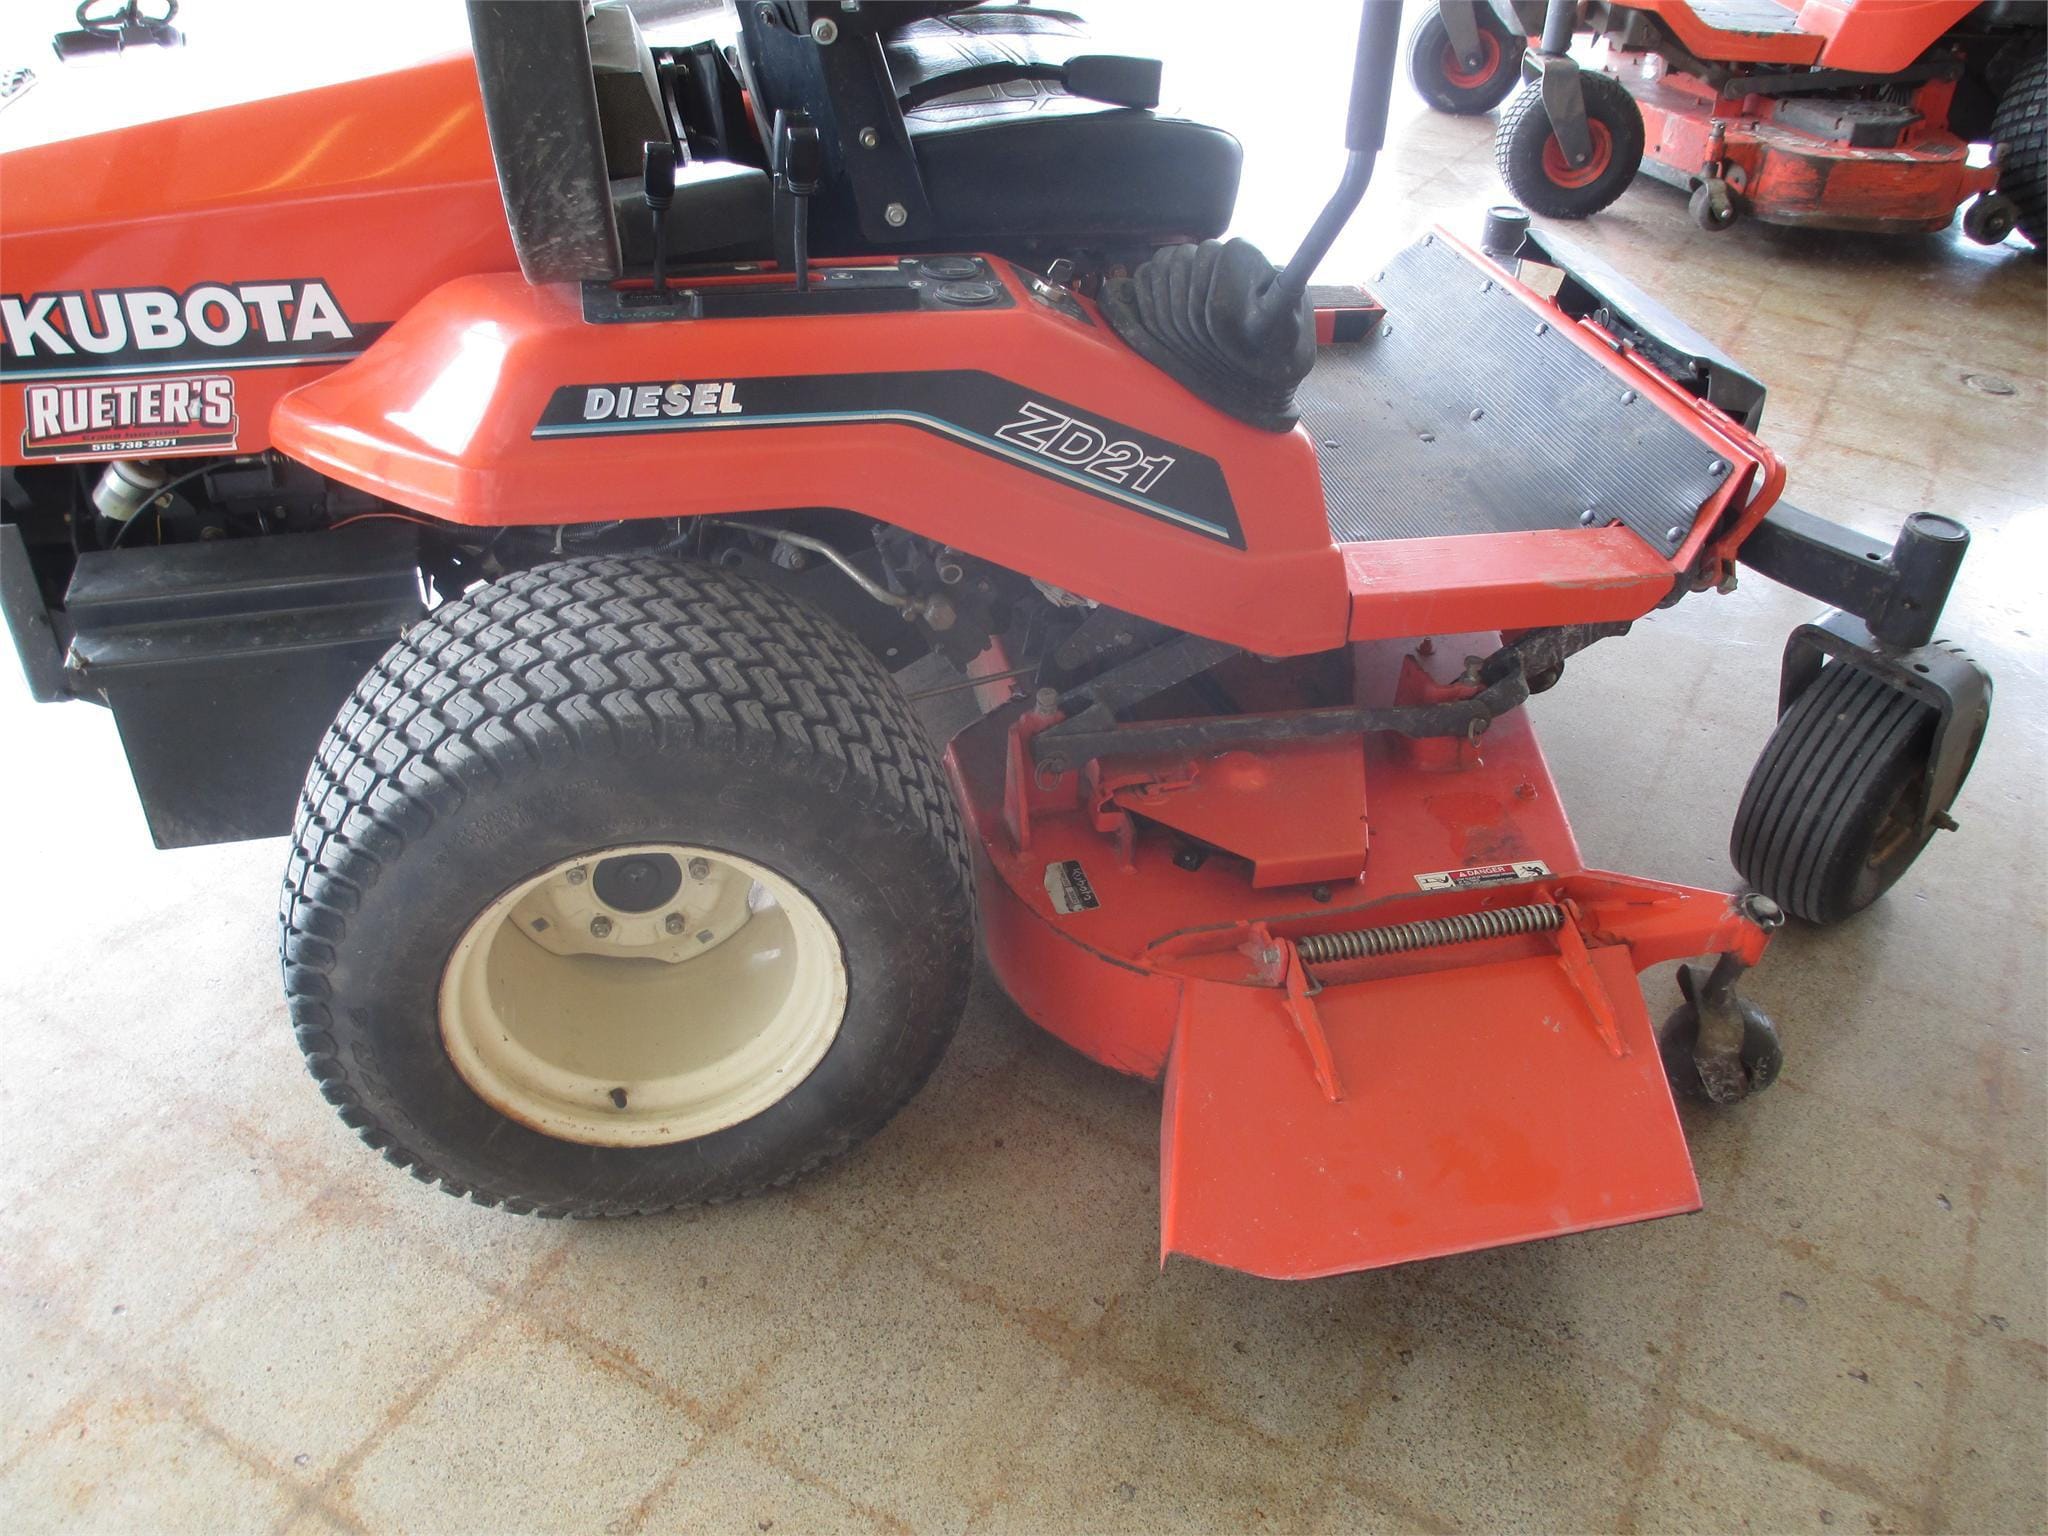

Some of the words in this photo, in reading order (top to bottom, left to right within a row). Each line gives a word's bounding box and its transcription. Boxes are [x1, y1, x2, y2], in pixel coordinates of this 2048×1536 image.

[1, 282, 354, 358] KUBOTA
[31, 379, 232, 439] RUETER'S
[582, 382, 743, 420] DIESEL
[92, 438, 177, 452] 515-738-2571
[994, 401, 1177, 494] ZD21
[1466, 866, 1506, 877] DANGER
